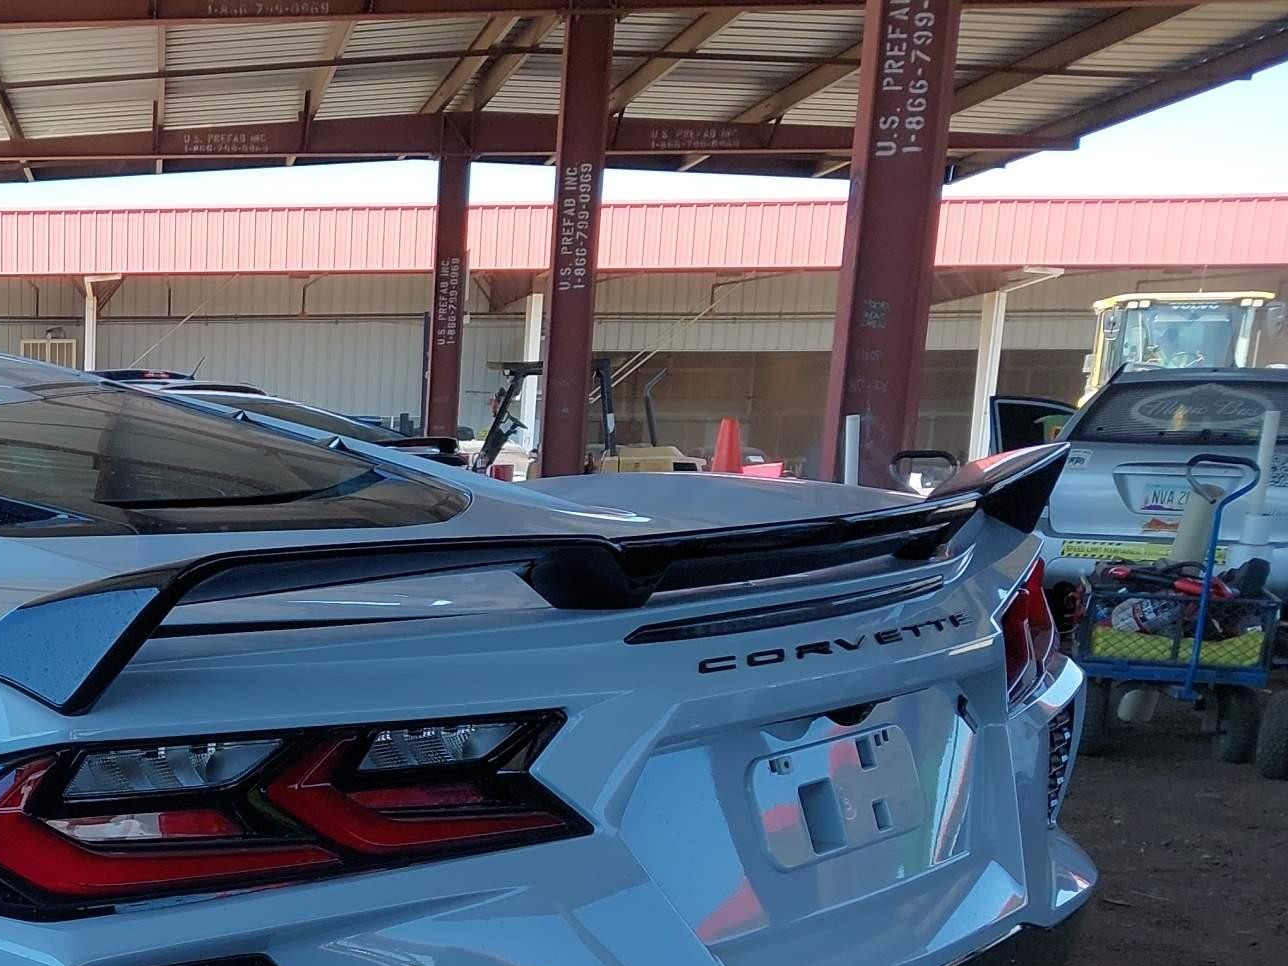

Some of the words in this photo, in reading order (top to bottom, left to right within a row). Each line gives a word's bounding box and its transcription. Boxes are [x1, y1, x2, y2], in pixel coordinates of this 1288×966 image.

[882, 0, 911, 91] PREFA
[875, 107, 900, 156] U.S.
[560, 198, 576, 255] PREFAB
[573, 163, 593, 289] 1-866-799-0969
[558, 263, 573, 290] U.S.
[698, 611, 975, 674] CORVETTE
